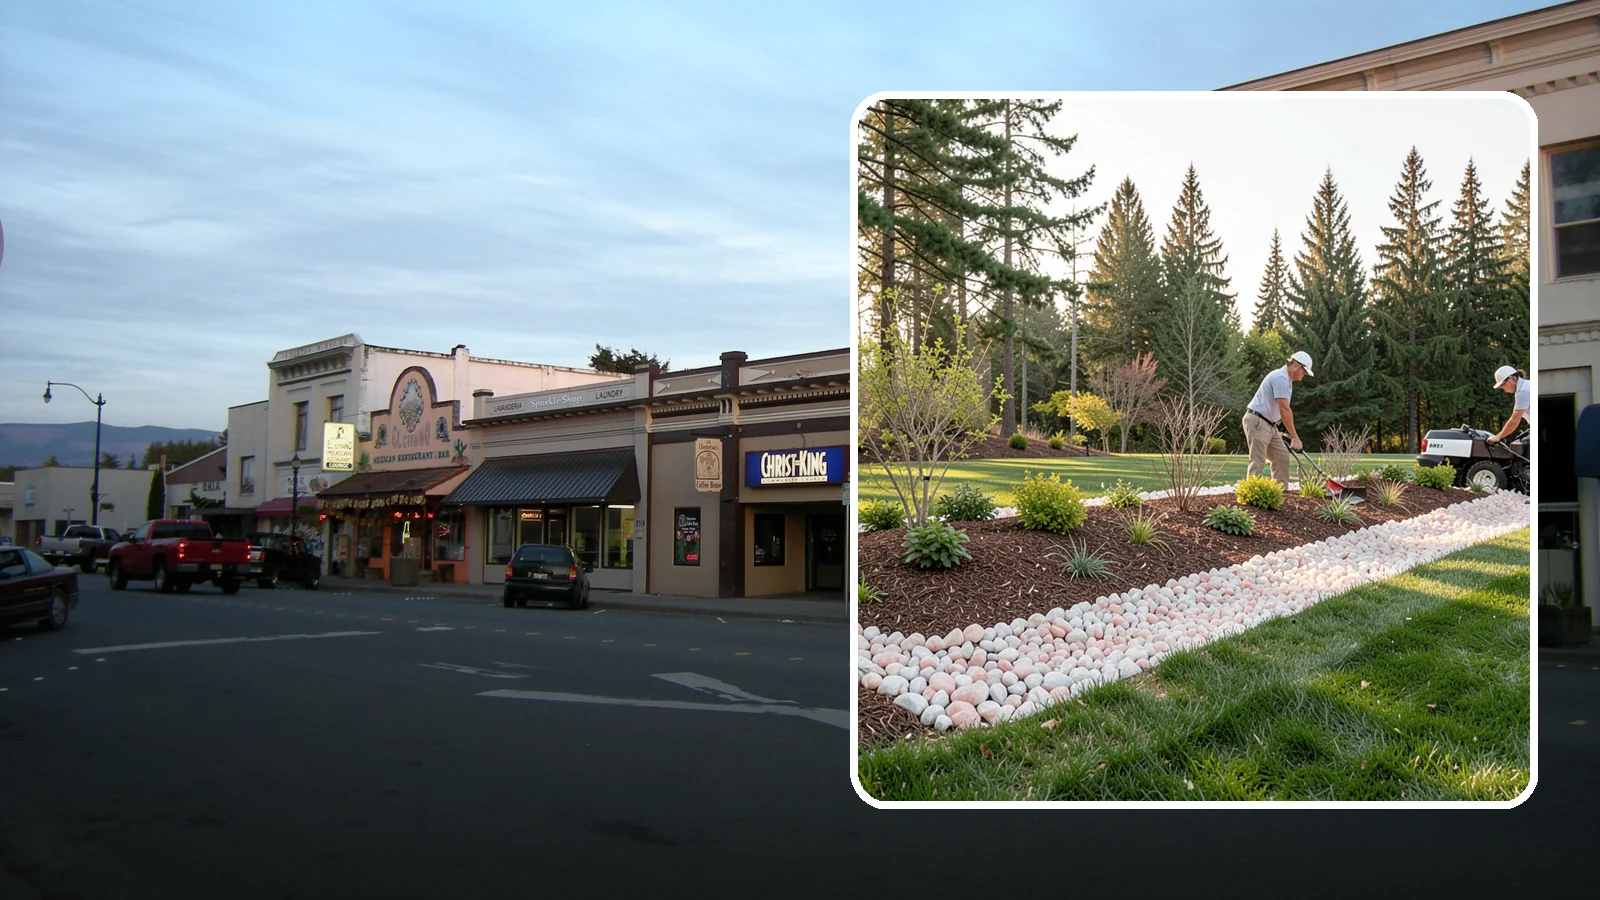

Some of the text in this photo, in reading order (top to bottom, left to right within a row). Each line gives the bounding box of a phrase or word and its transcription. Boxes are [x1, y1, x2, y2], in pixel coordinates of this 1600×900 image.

[595, 389, 624, 400] LAUNDRY
[493, 402, 522, 413] LAVANDERIA
[531, 394, 583, 409] Sparkle Shop
[397, 451, 434, 462] RESTAURANT
[438, 450, 450, 459] BAR
[760, 450, 828, 478] CHRIST KING
